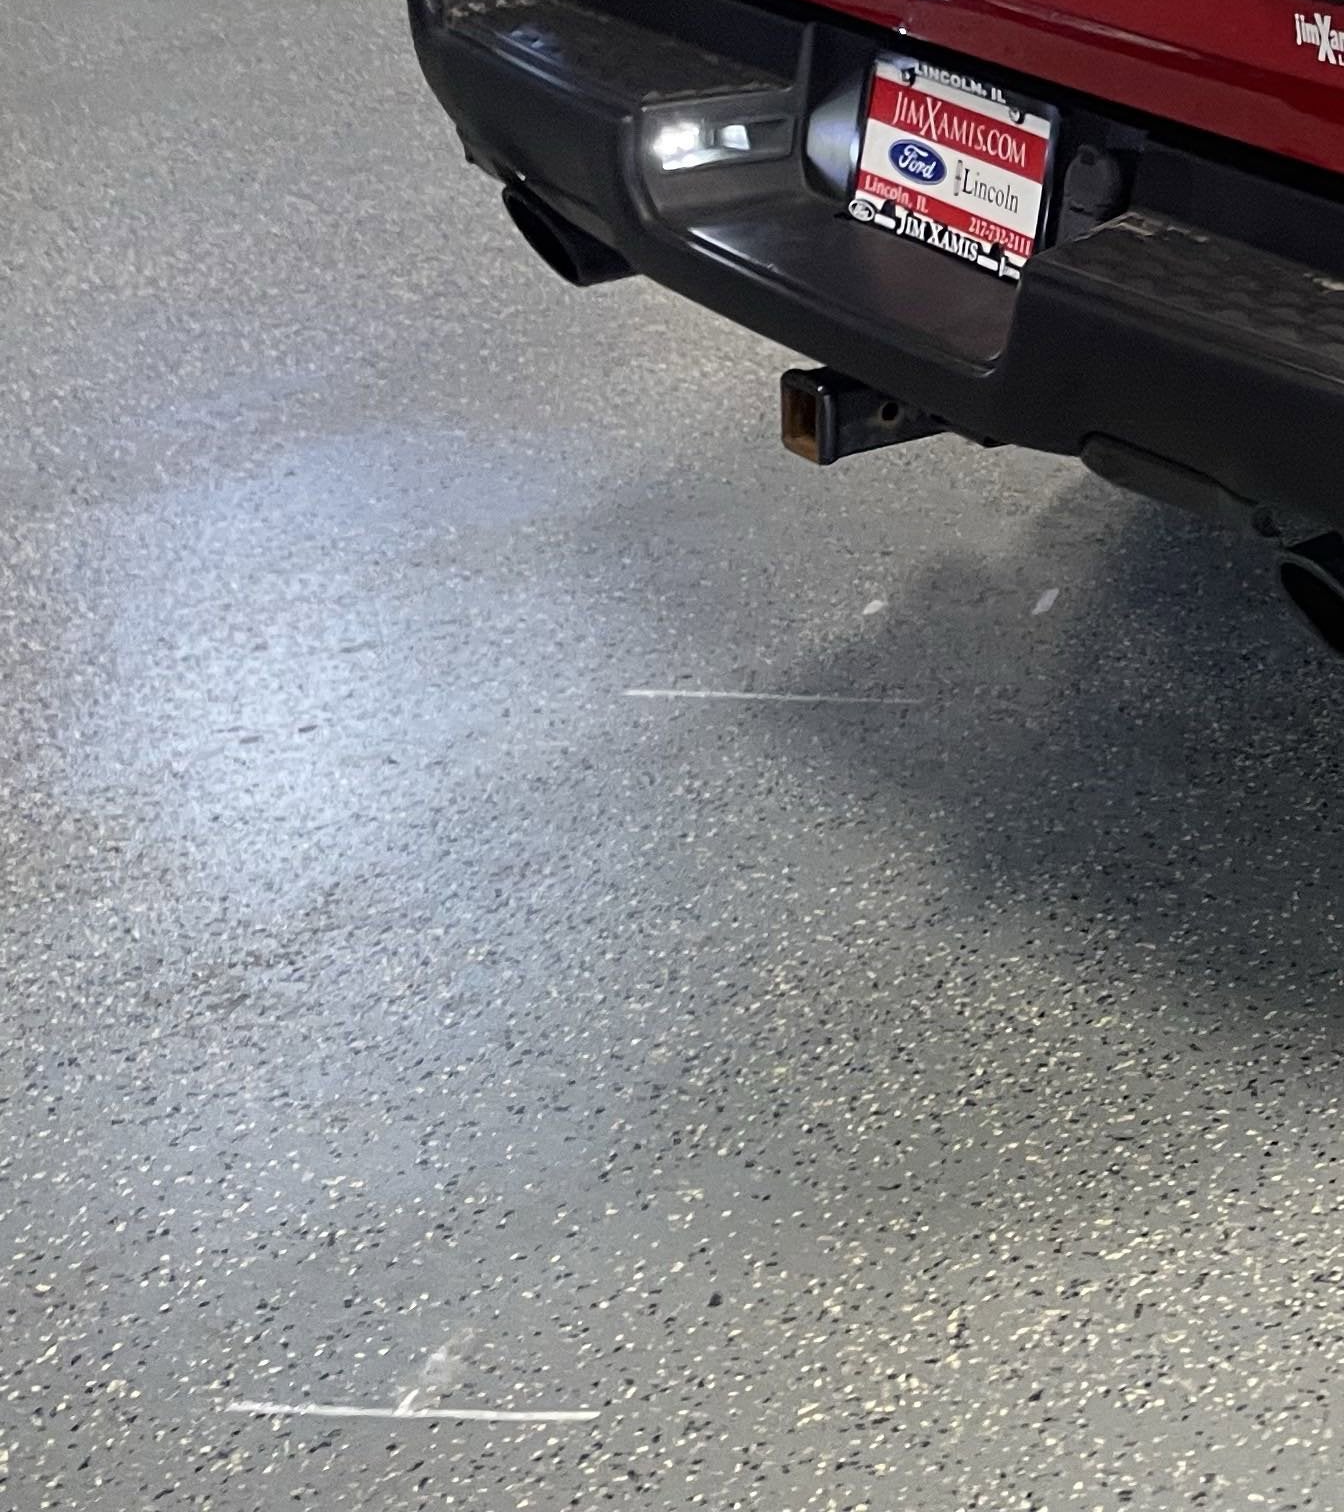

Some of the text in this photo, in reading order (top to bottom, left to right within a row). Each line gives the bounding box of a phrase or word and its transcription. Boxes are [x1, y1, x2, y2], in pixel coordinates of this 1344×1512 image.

[991, 87, 1007, 104] IL
[898, 144, 938, 180] Ford
[962, 167, 1020, 214] Lincoln
[916, 196, 929, 214] IL
